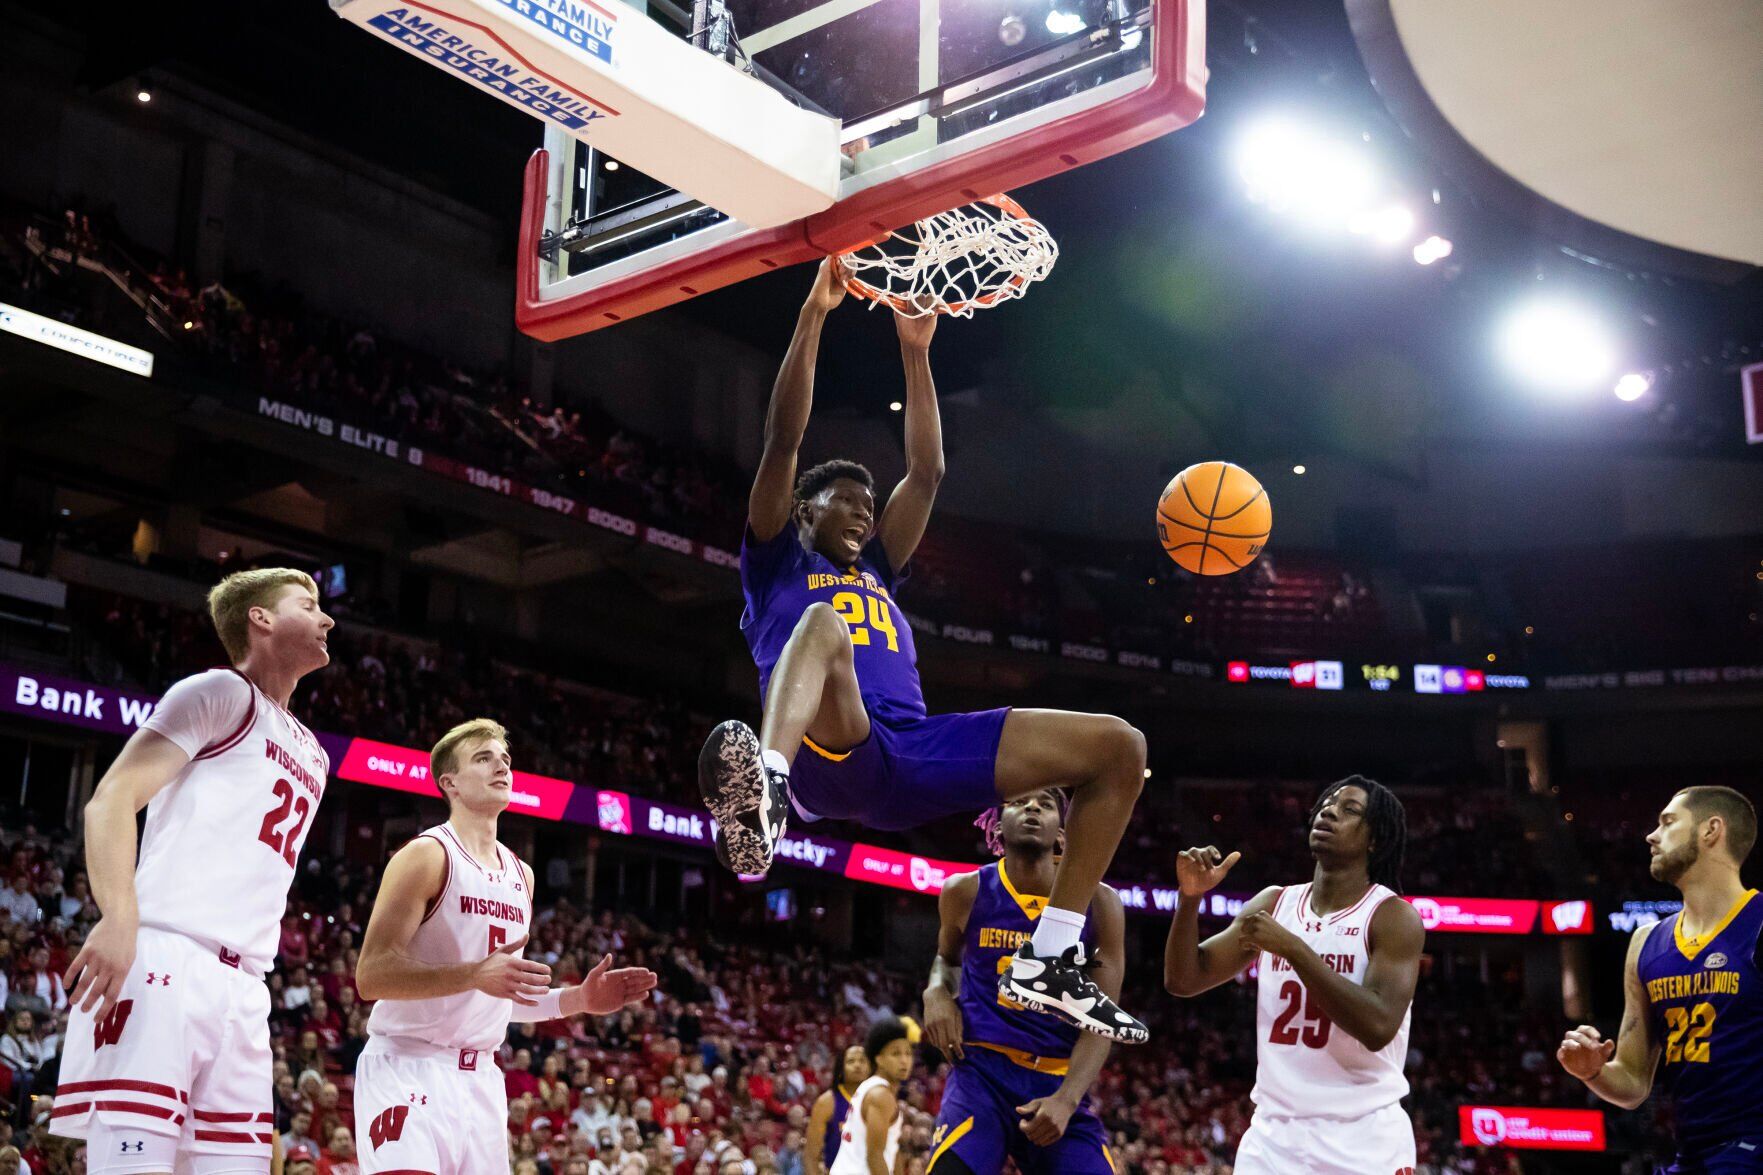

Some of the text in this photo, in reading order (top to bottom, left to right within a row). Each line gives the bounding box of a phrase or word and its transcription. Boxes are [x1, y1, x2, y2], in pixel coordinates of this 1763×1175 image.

[386, 8, 604, 122] AMERICAN FAMILY
[386, 25, 572, 121] INSURANCE
[258, 396, 333, 437] MEN'S
[339, 424, 399, 459] ELITE
[466, 467, 512, 496] 1941
[530, 488, 575, 515] 1947
[587, 506, 636, 536] 2000
[832, 591, 899, 653] 24
[943, 623, 994, 644] FOUR
[15, 676, 104, 720] Bank
[1249, 665, 1292, 680] TOYOTA
[265, 738, 323, 803] WISCONSIN
[367, 756, 429, 780] ONLY AT
[257, 778, 310, 870] 22
[648, 806, 704, 839] Bank
[459, 895, 525, 926] WISCONSIN
[1682, 971, 1741, 995] ILLINOIS
[1268, 979, 1332, 1050] 25
[1664, 1001, 1717, 1067] 22
